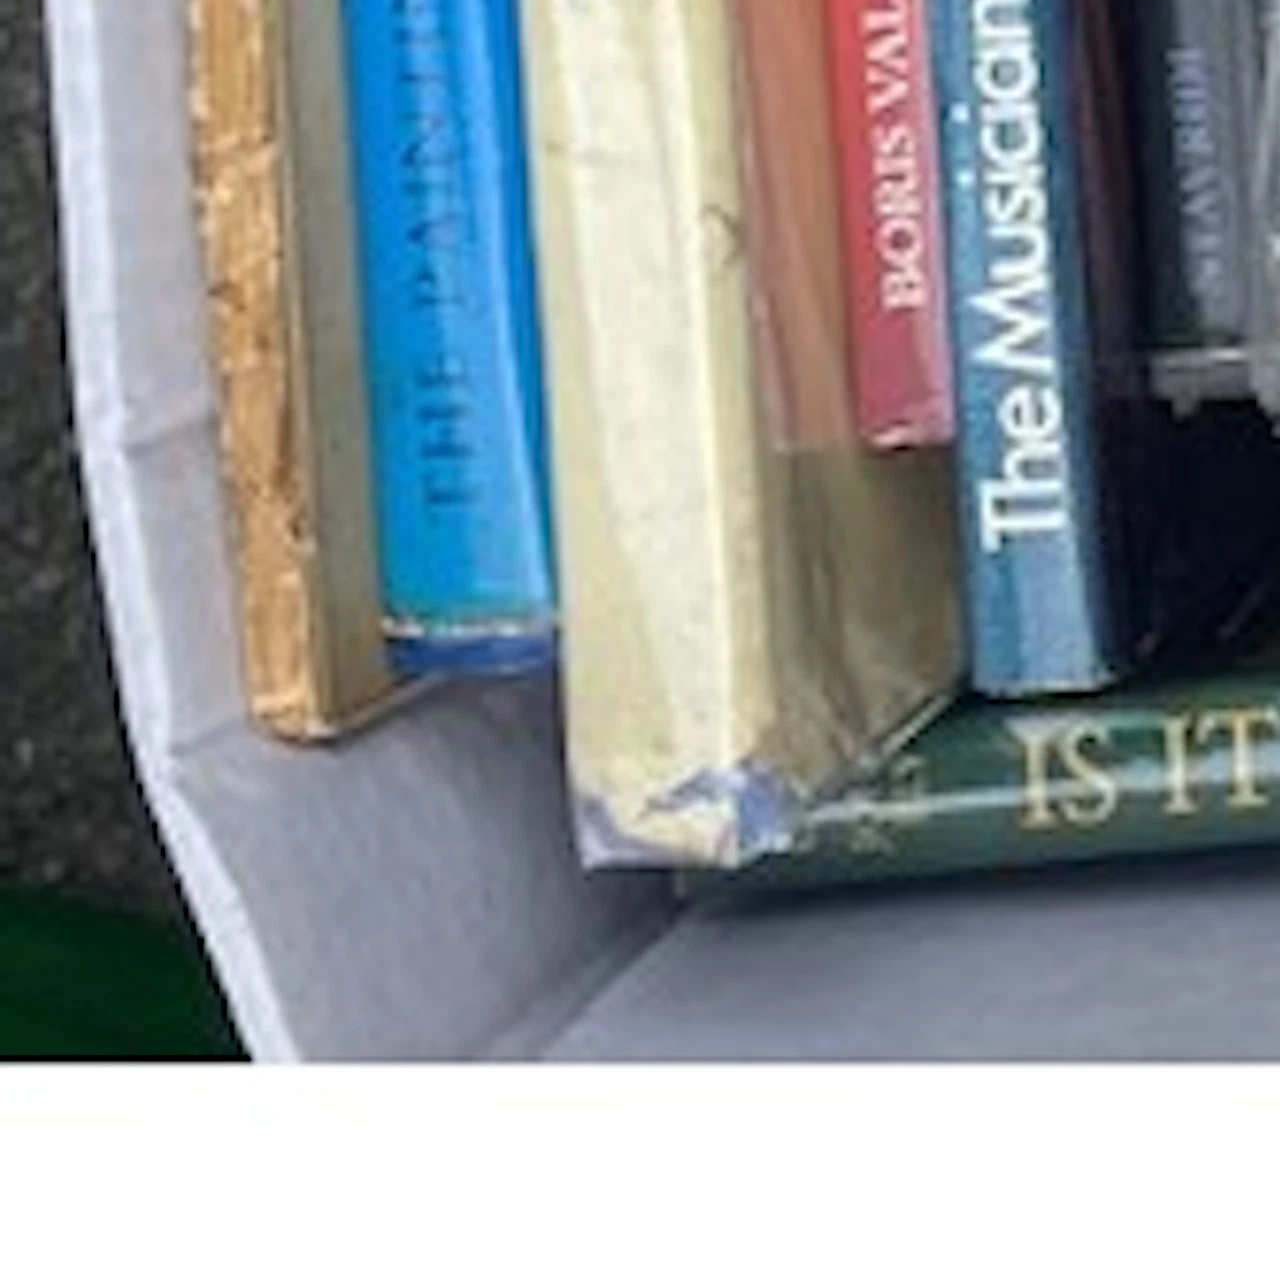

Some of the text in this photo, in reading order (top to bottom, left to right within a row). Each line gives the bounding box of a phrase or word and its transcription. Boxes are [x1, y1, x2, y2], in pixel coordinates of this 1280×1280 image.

[876, 129, 930, 312] BORIS
[418, 350, 476, 514] THE
[980, 395, 1066, 552] The
[1019, 720, 1120, 829] IS
